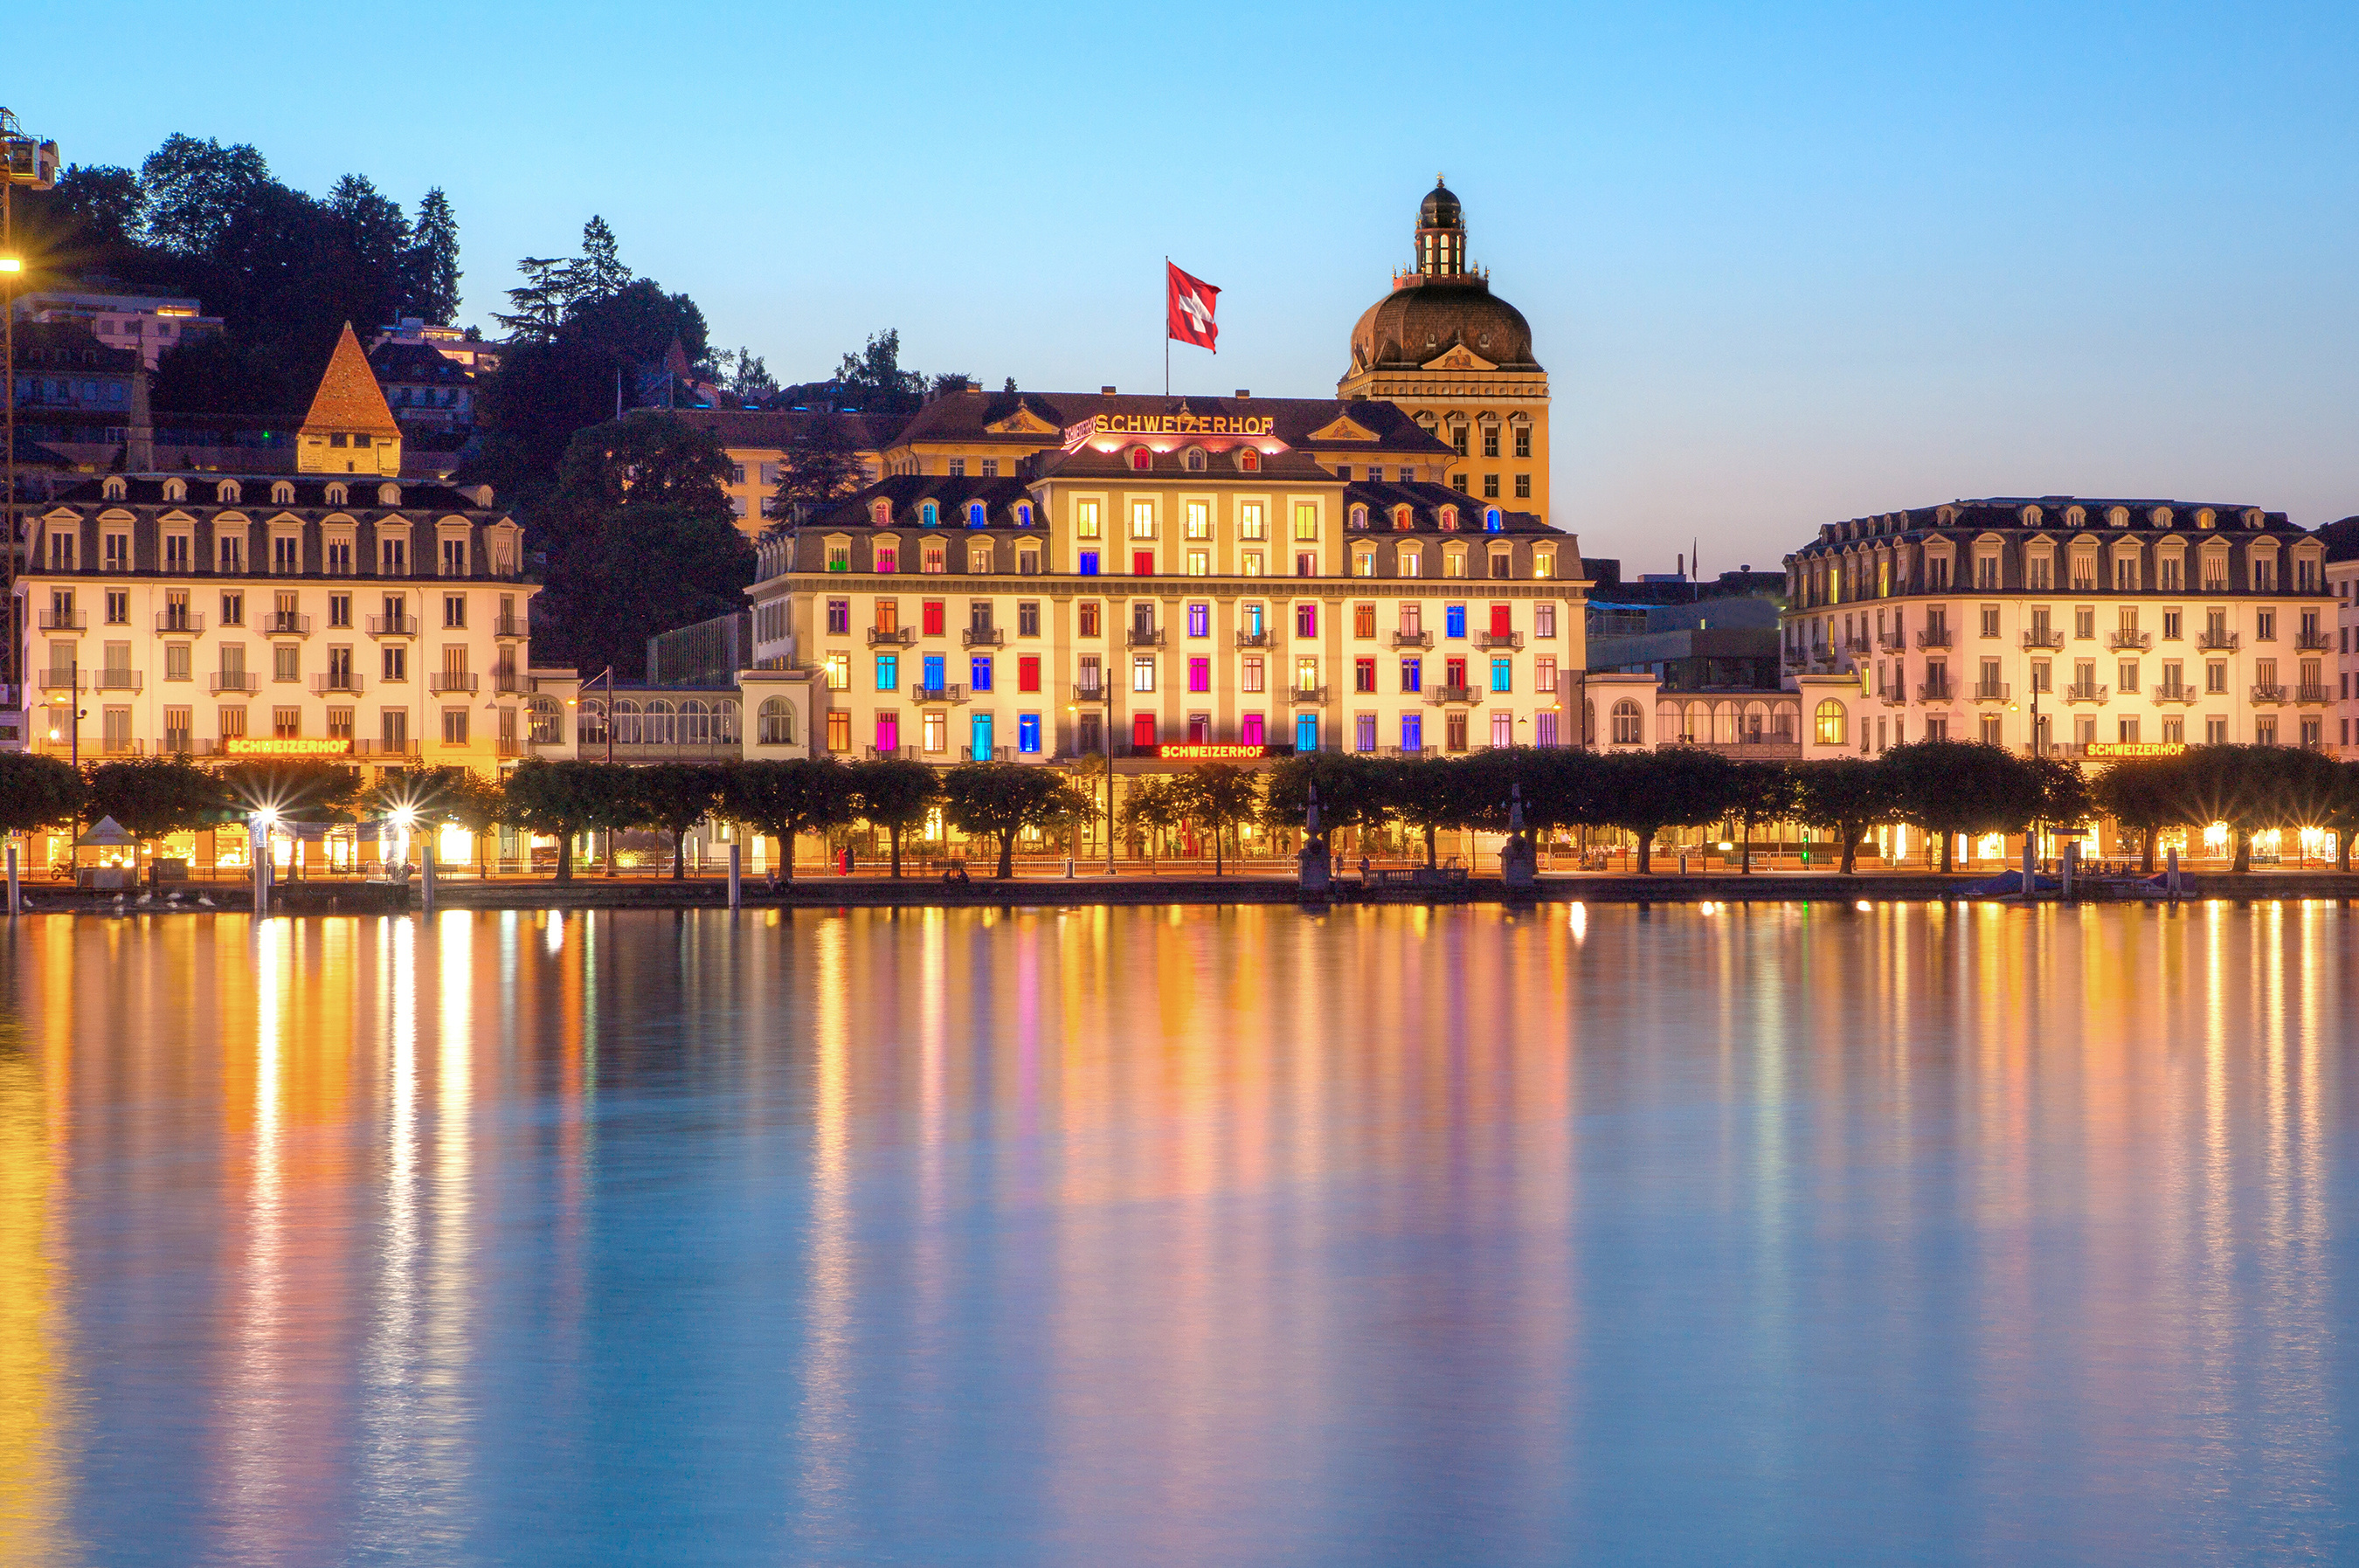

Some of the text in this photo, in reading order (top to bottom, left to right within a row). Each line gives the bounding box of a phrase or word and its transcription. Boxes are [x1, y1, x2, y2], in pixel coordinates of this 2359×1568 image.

[1095, 414, 1274, 434] SCHWEIZERHOF
[228, 740, 349, 753] SCHWEIZERHOF
[1161, 745, 1264, 757] SCHWEIZERHOF
[2087, 743, 2185, 756] SCHWEIZERHOF
